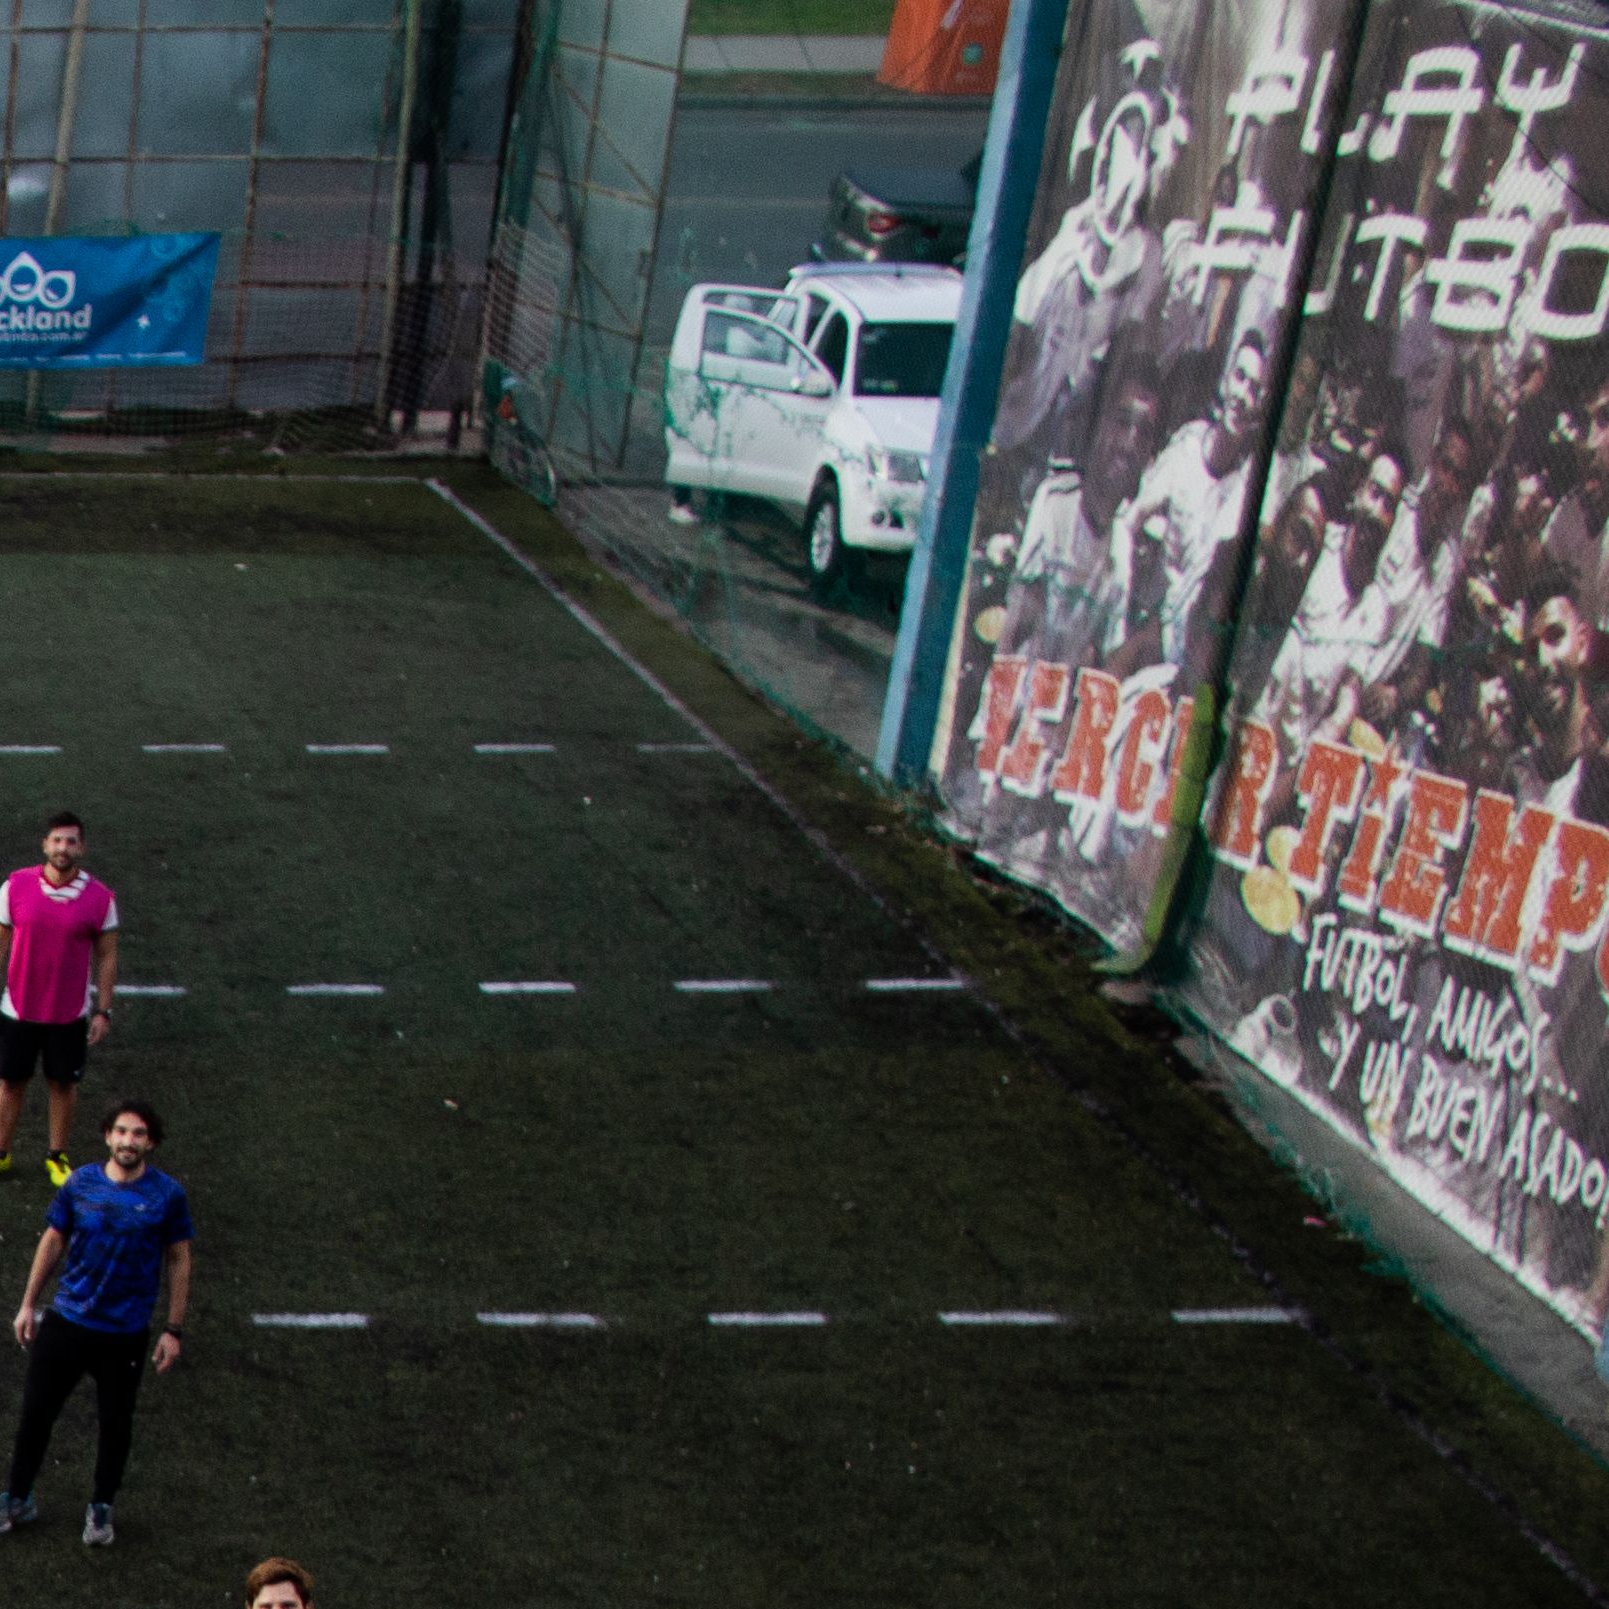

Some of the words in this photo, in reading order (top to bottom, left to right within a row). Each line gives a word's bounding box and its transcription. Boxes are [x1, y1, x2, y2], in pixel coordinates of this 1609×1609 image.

[1224, 43, 1586, 170] PLAY
[1288, 738, 1609, 1000] TIEMP
[1328, 1014, 1361, 1090] Y
[1359, 1040, 1414, 1118] UN
[1405, 1053, 1505, 1164] BUEN
